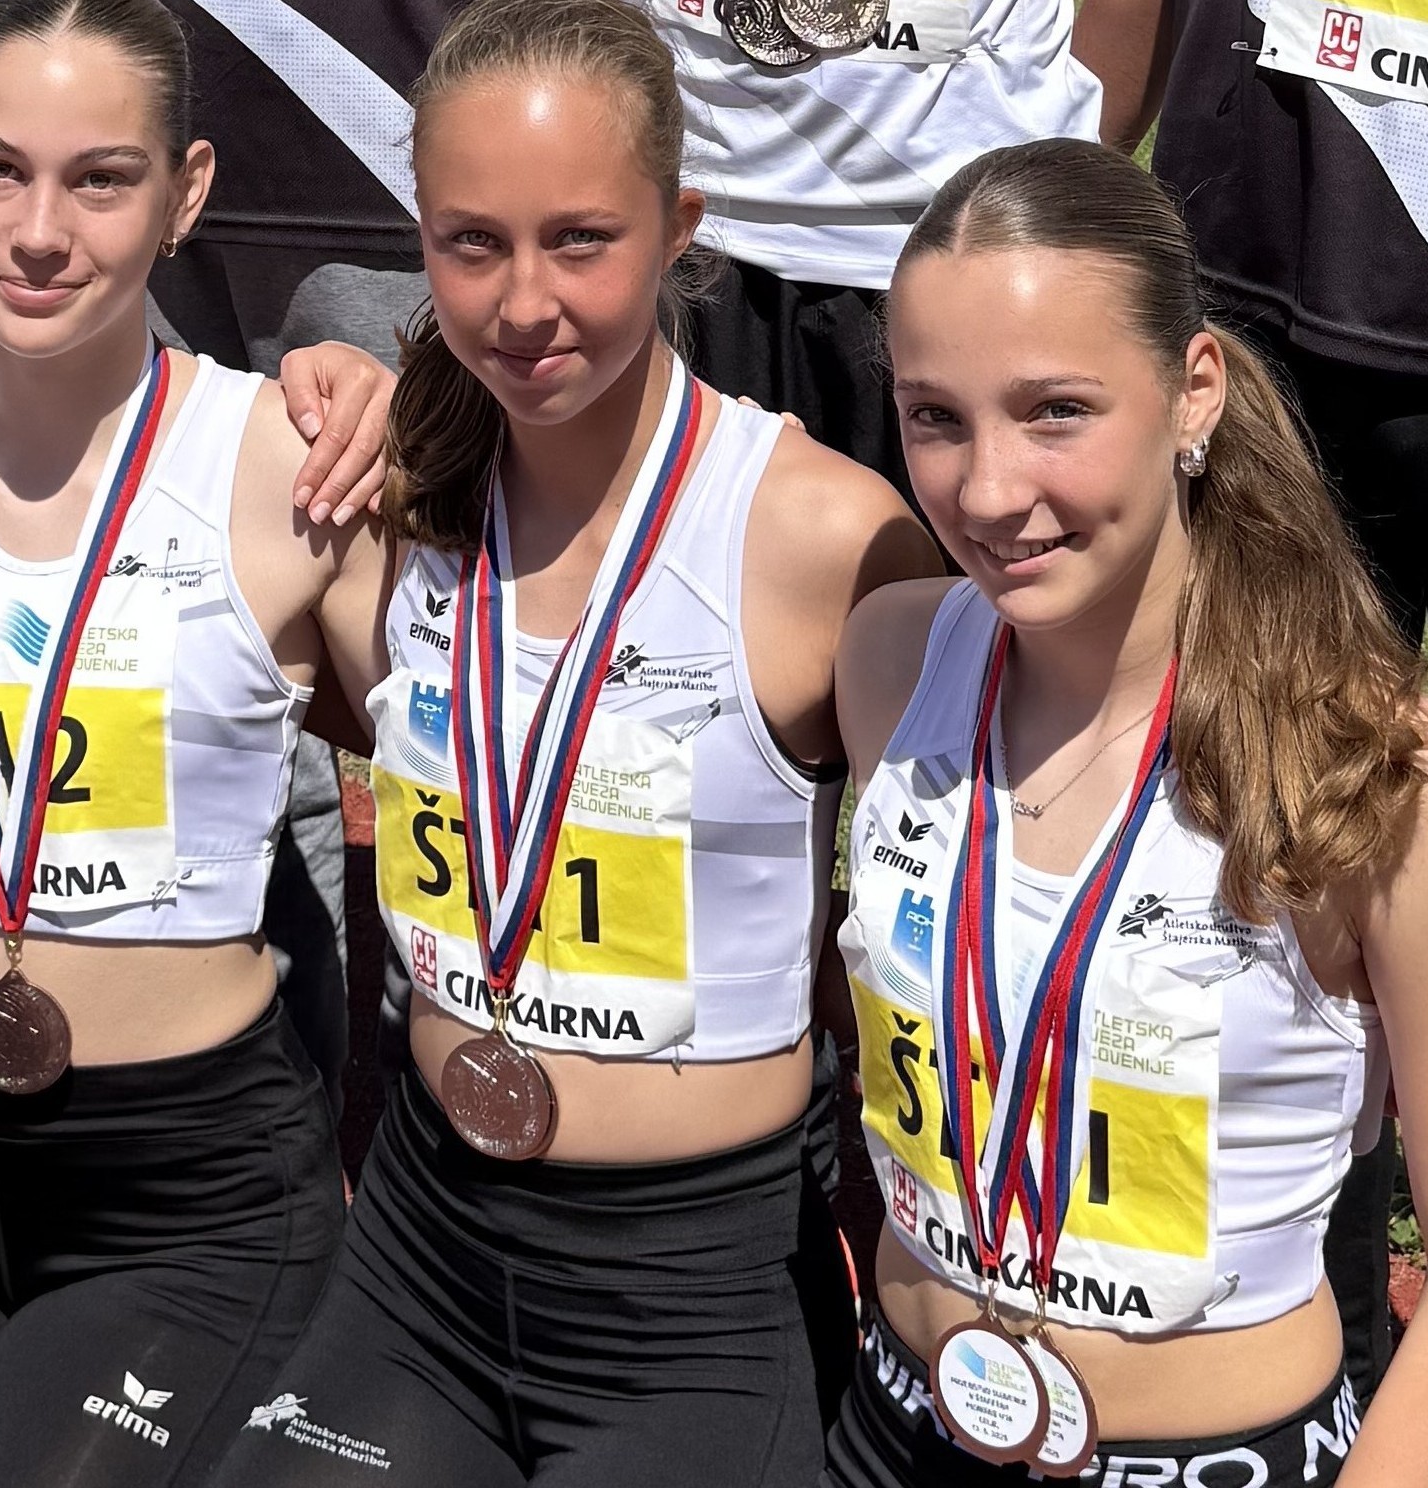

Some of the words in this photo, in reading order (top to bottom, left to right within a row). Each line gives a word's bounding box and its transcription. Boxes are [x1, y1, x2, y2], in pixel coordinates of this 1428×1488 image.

[78, 643, 105, 655] EZA
[409, 620, 451, 651] erima
[48, 716, 91, 804] 2
[572, 779, 620, 800] ZVEZA
[570, 796, 653, 821] SLOVENIJE
[873, 845, 927, 878] erima
[566, 857, 600, 944] 1
[1094, 1009, 1174, 1042] TLETSKA
[83, 1395, 170, 1448] erima
[290, 1417, 337, 1440] Atletsko
[337, 1434, 386, 1456] društvo
[284, 1425, 337, 1453] Štajerska
[338, 1446, 391, 1470] Maribor
